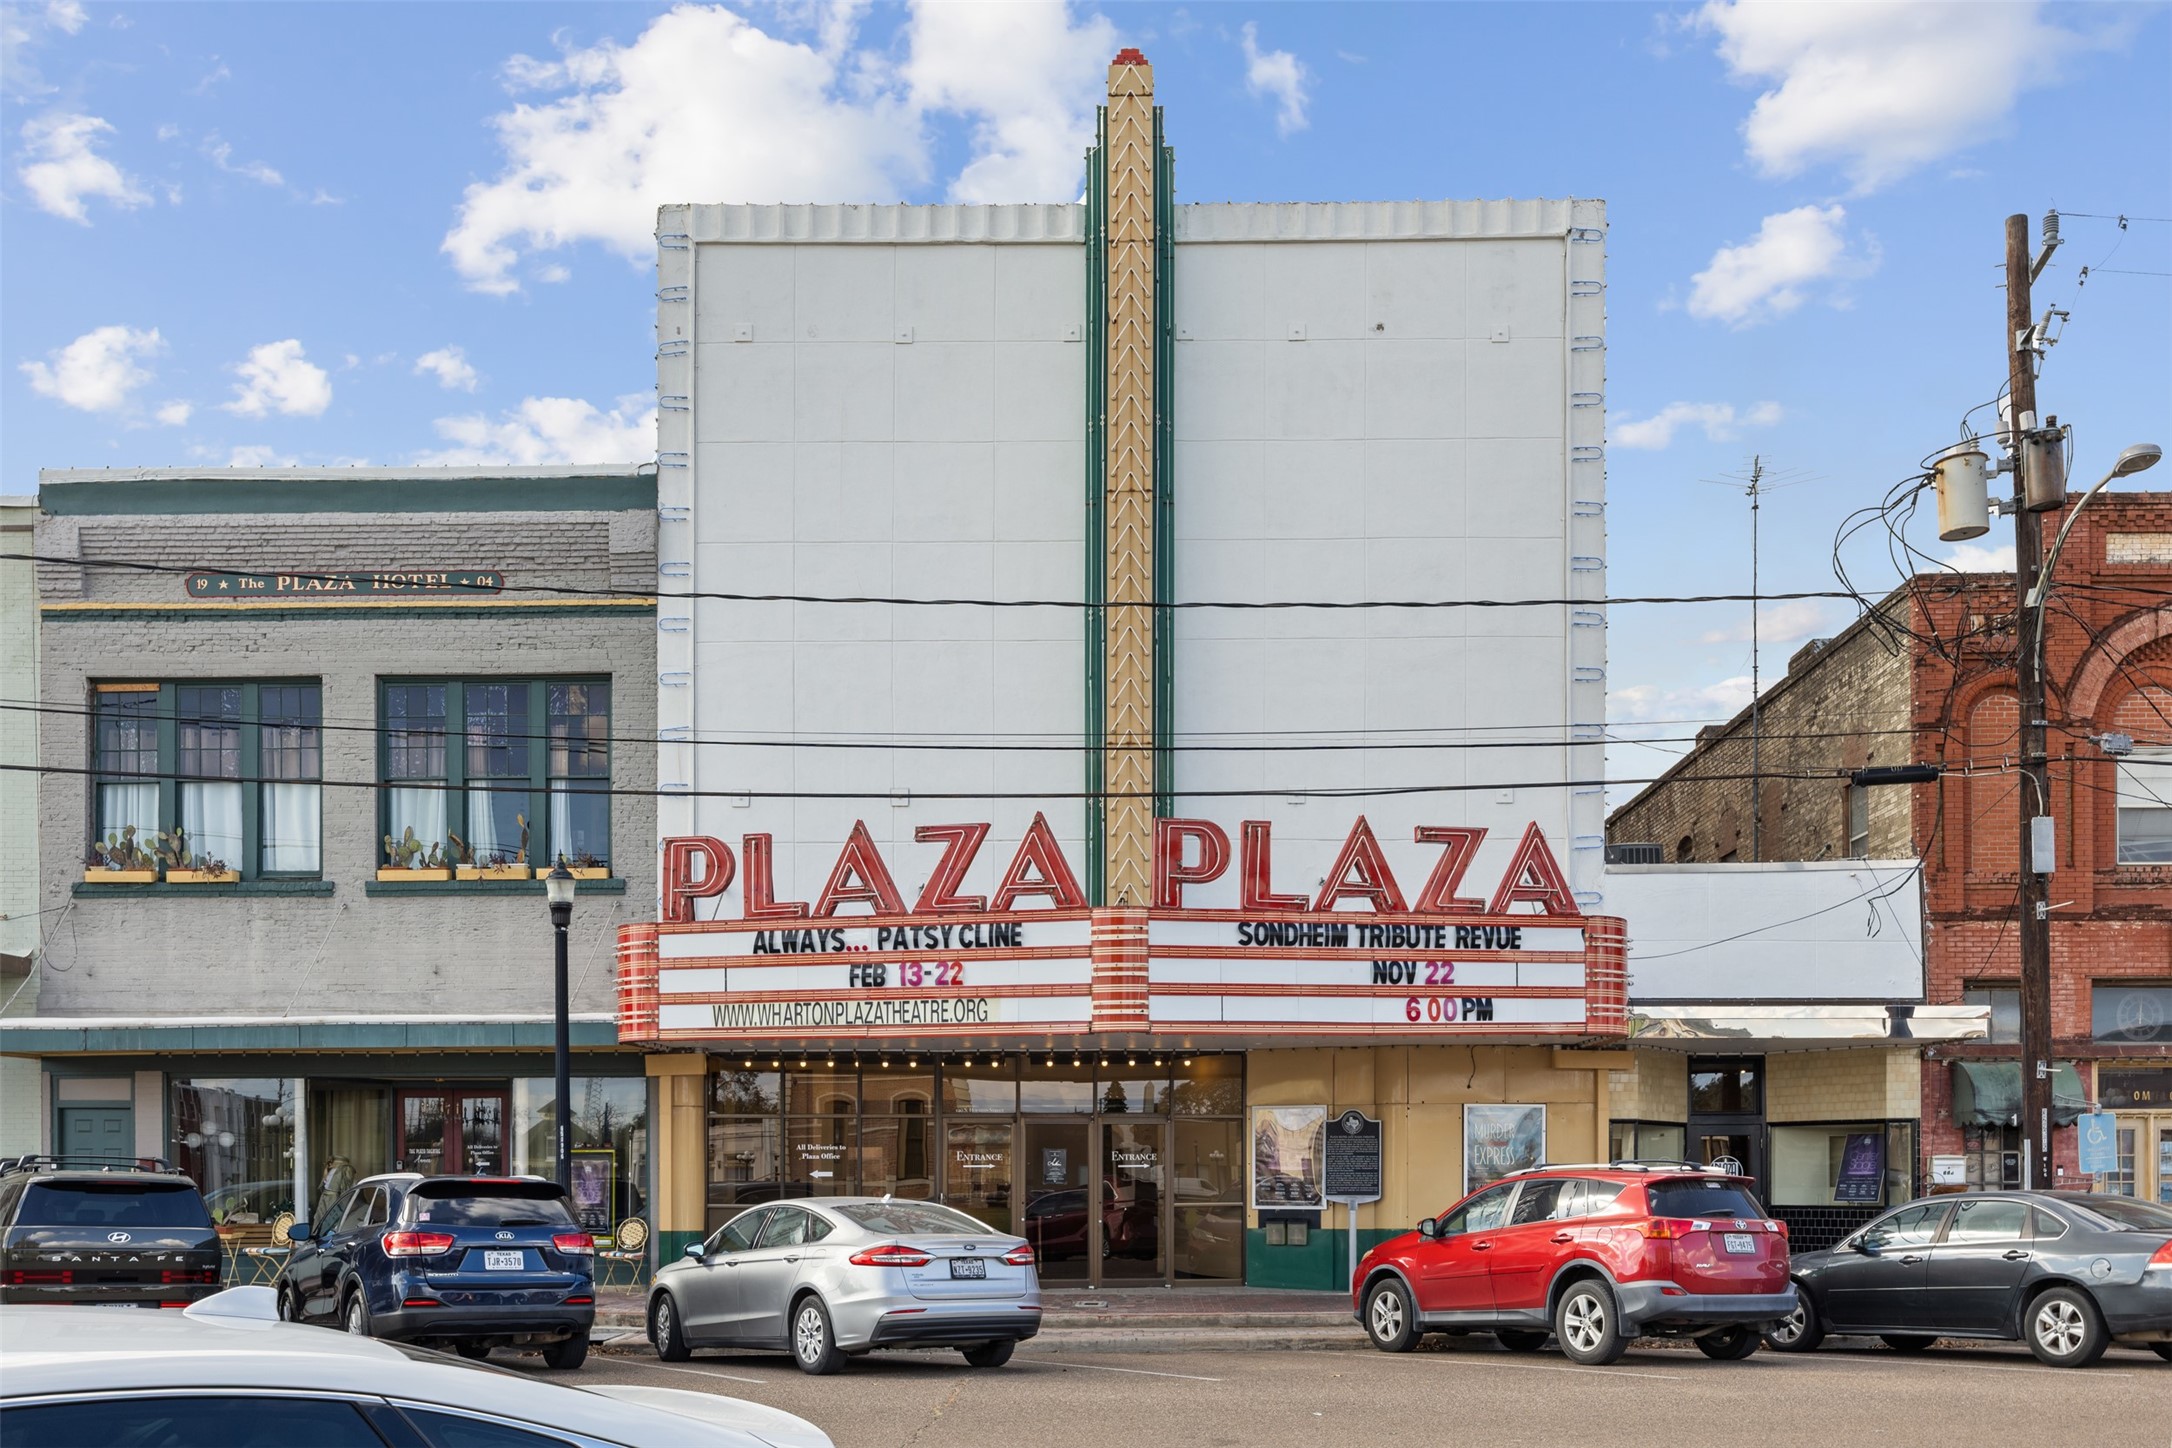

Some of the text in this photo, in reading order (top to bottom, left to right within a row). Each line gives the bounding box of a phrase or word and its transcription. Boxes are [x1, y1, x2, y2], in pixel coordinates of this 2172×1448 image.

[196, 573, 494, 591] 19 The PLAZA HOTEL 04
[662, 811, 1088, 922] PLAZA
[1152, 814, 1581, 915] PLAZA
[753, 922, 1022, 954] ALWAYS... PATSY CLINE
[1238, 921, 1522, 949] SONDHEIM TRIBUTE REVUE
[849, 961, 964, 988] FEB 13-22
[1373, 960, 1455, 985] NOV 22
[712, 998, 989, 1027] WWW.WHARTONPLAZATHEATRE.ORG
[1474, 1123, 1515, 1139] MURDER
[956, 1150, 1004, 1161] ENTRANCE
[1111, 1150, 1158, 1161] ENTRANCE
[1474, 1145, 1515, 1165] EXPRESS
